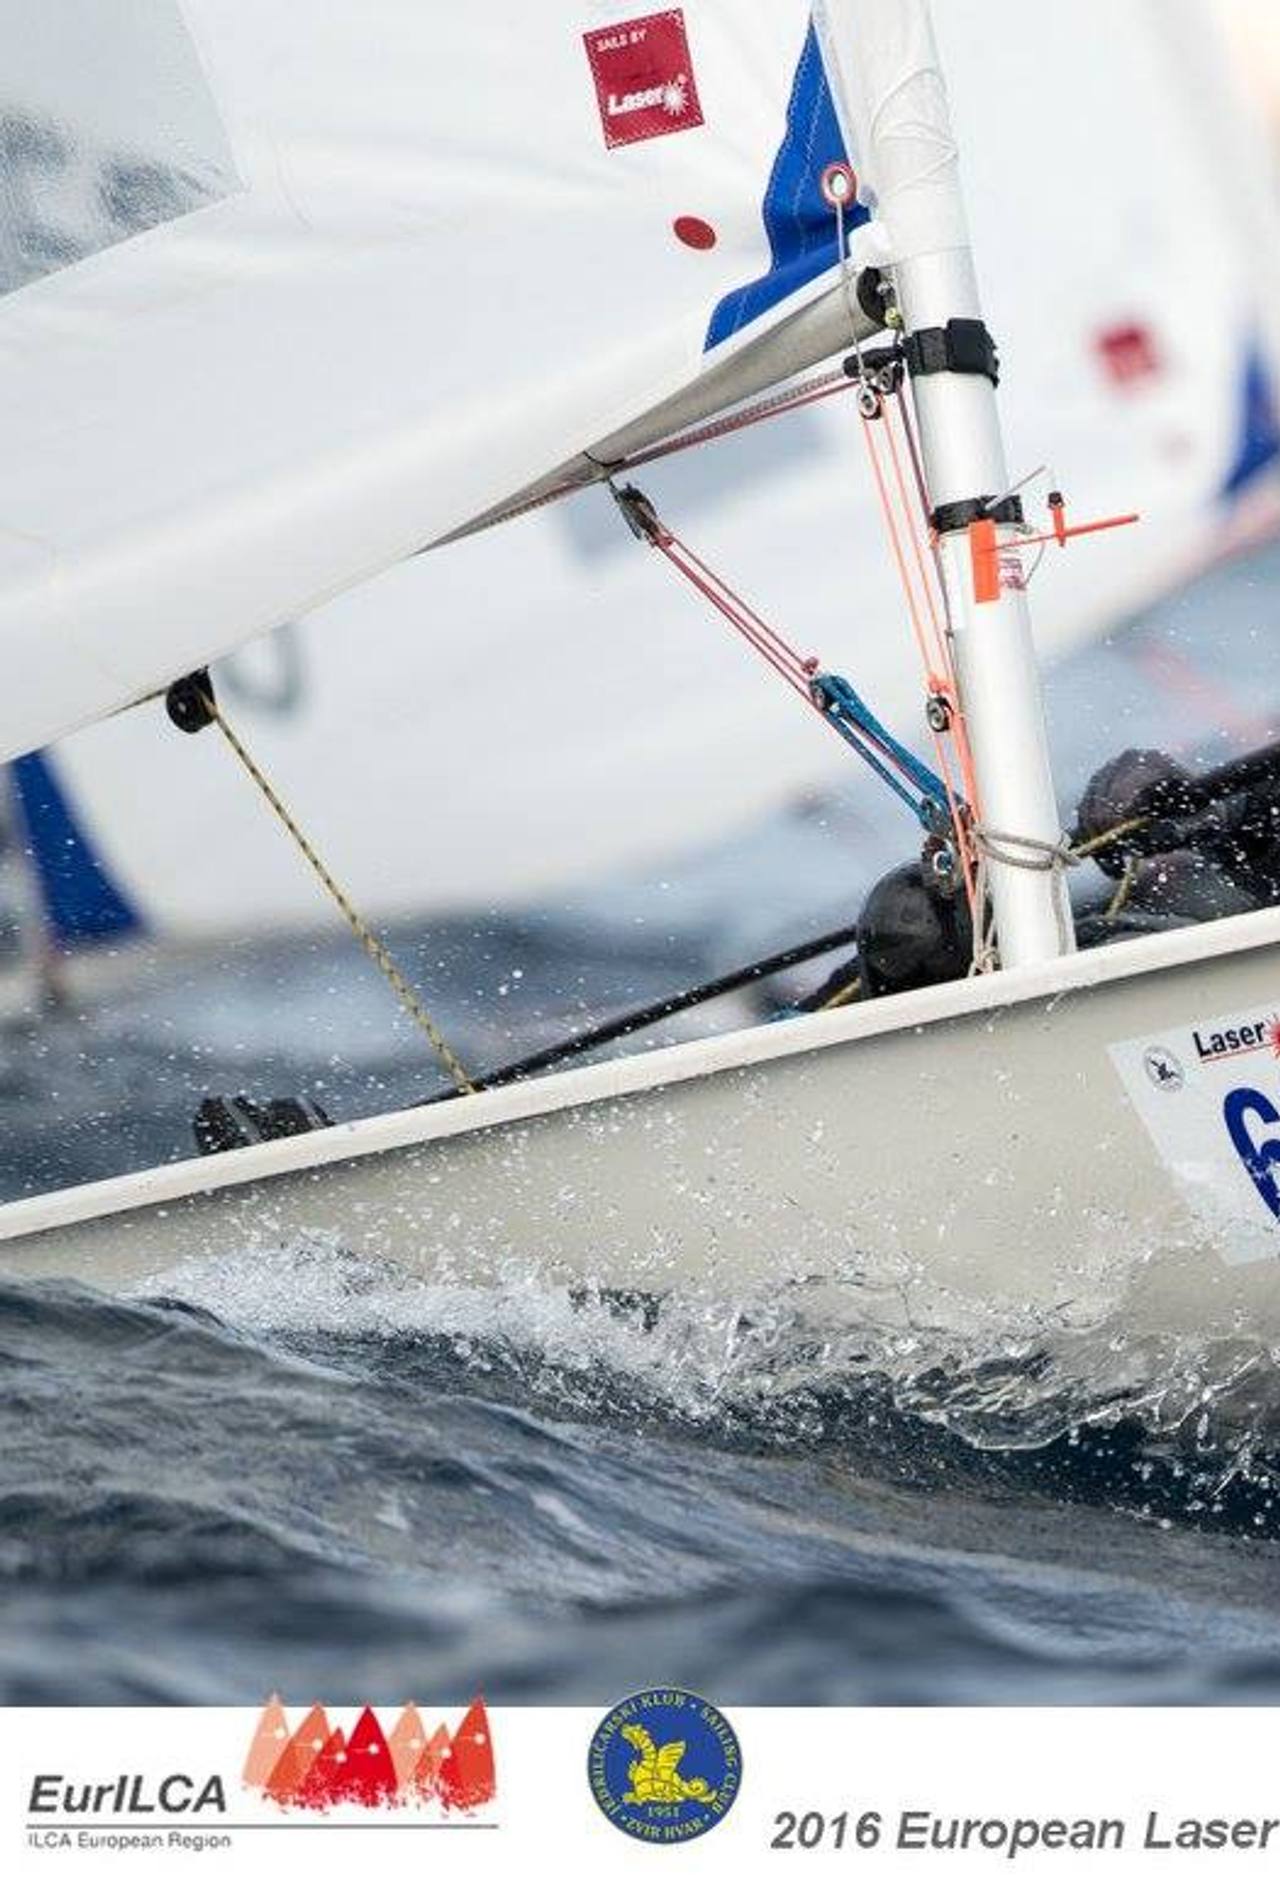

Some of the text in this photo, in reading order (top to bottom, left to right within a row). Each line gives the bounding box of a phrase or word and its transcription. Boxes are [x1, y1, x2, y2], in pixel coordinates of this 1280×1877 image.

[629, 29, 647, 43] BY
[606, 85, 663, 116] Laser
[1193, 1021, 1266, 1058] Laser
